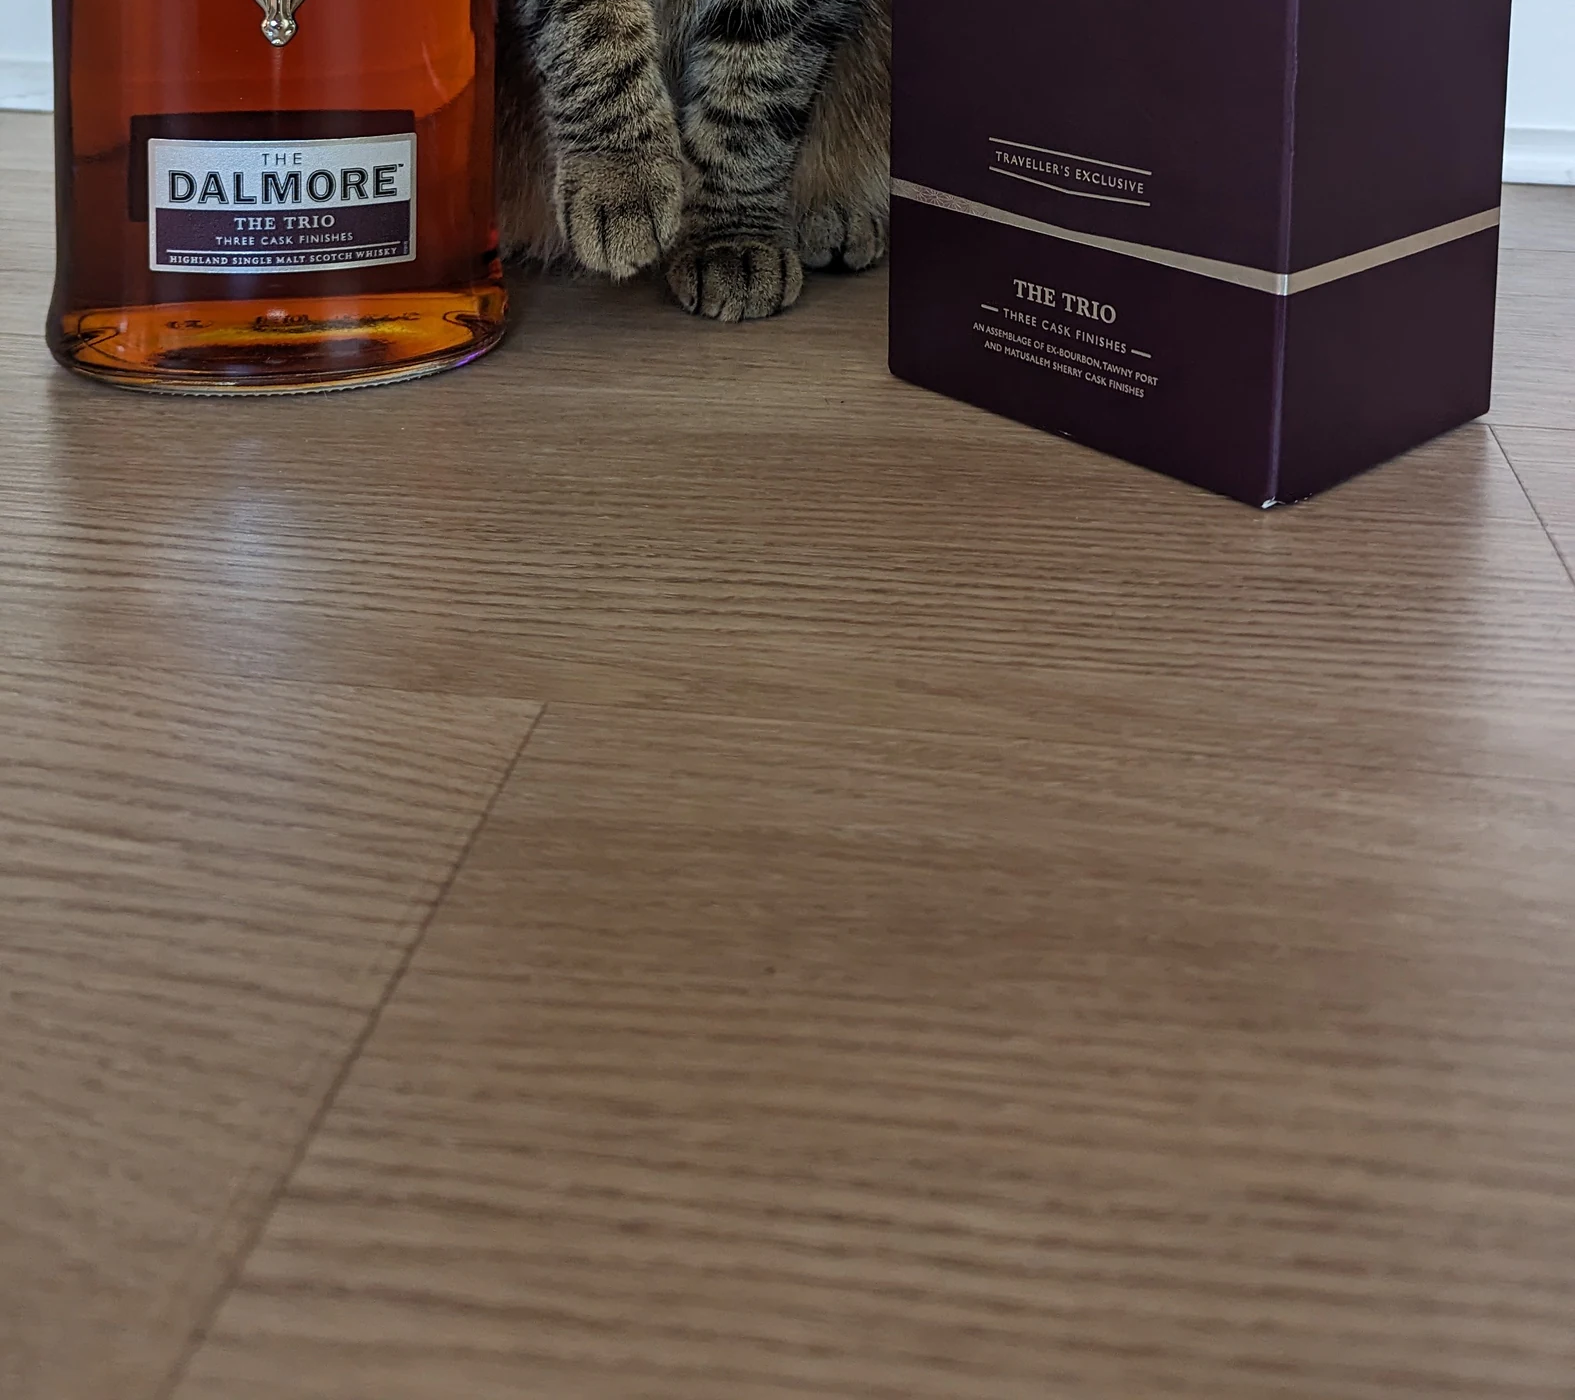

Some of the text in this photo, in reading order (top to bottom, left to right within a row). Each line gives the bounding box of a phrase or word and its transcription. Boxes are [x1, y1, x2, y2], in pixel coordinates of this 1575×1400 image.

[262, 152, 302, 165] THE
[995, 151, 1144, 194] TRAVELLER'S EXCLUSIVE
[216, 232, 353, 246] THREE CASK FINISHES
[234, 214, 335, 231] THE TRIO
[169, 255, 228, 264] HIGHLAND
[232, 256, 272, 265] SINGLE
[276, 255, 305, 263] MALT
[310, 252, 353, 262] SCOTCH
[355, 247, 398, 259] WHISKY
[1013, 279, 1116, 324] THE TRIO
[1003, 308, 1127, 354] THREE CASK FINISHES
[973, 322, 985, 331] AN
[985, 326, 1032, 347] ASSEMBLAGE
[1034, 340, 1045, 350] OF
[1102, 362, 1133, 378] TAWNY
[1135, 372, 1158, 386] PORT
[984, 340, 1144, 398] AND MATUSALEM SHERRY CASK FINISHES
